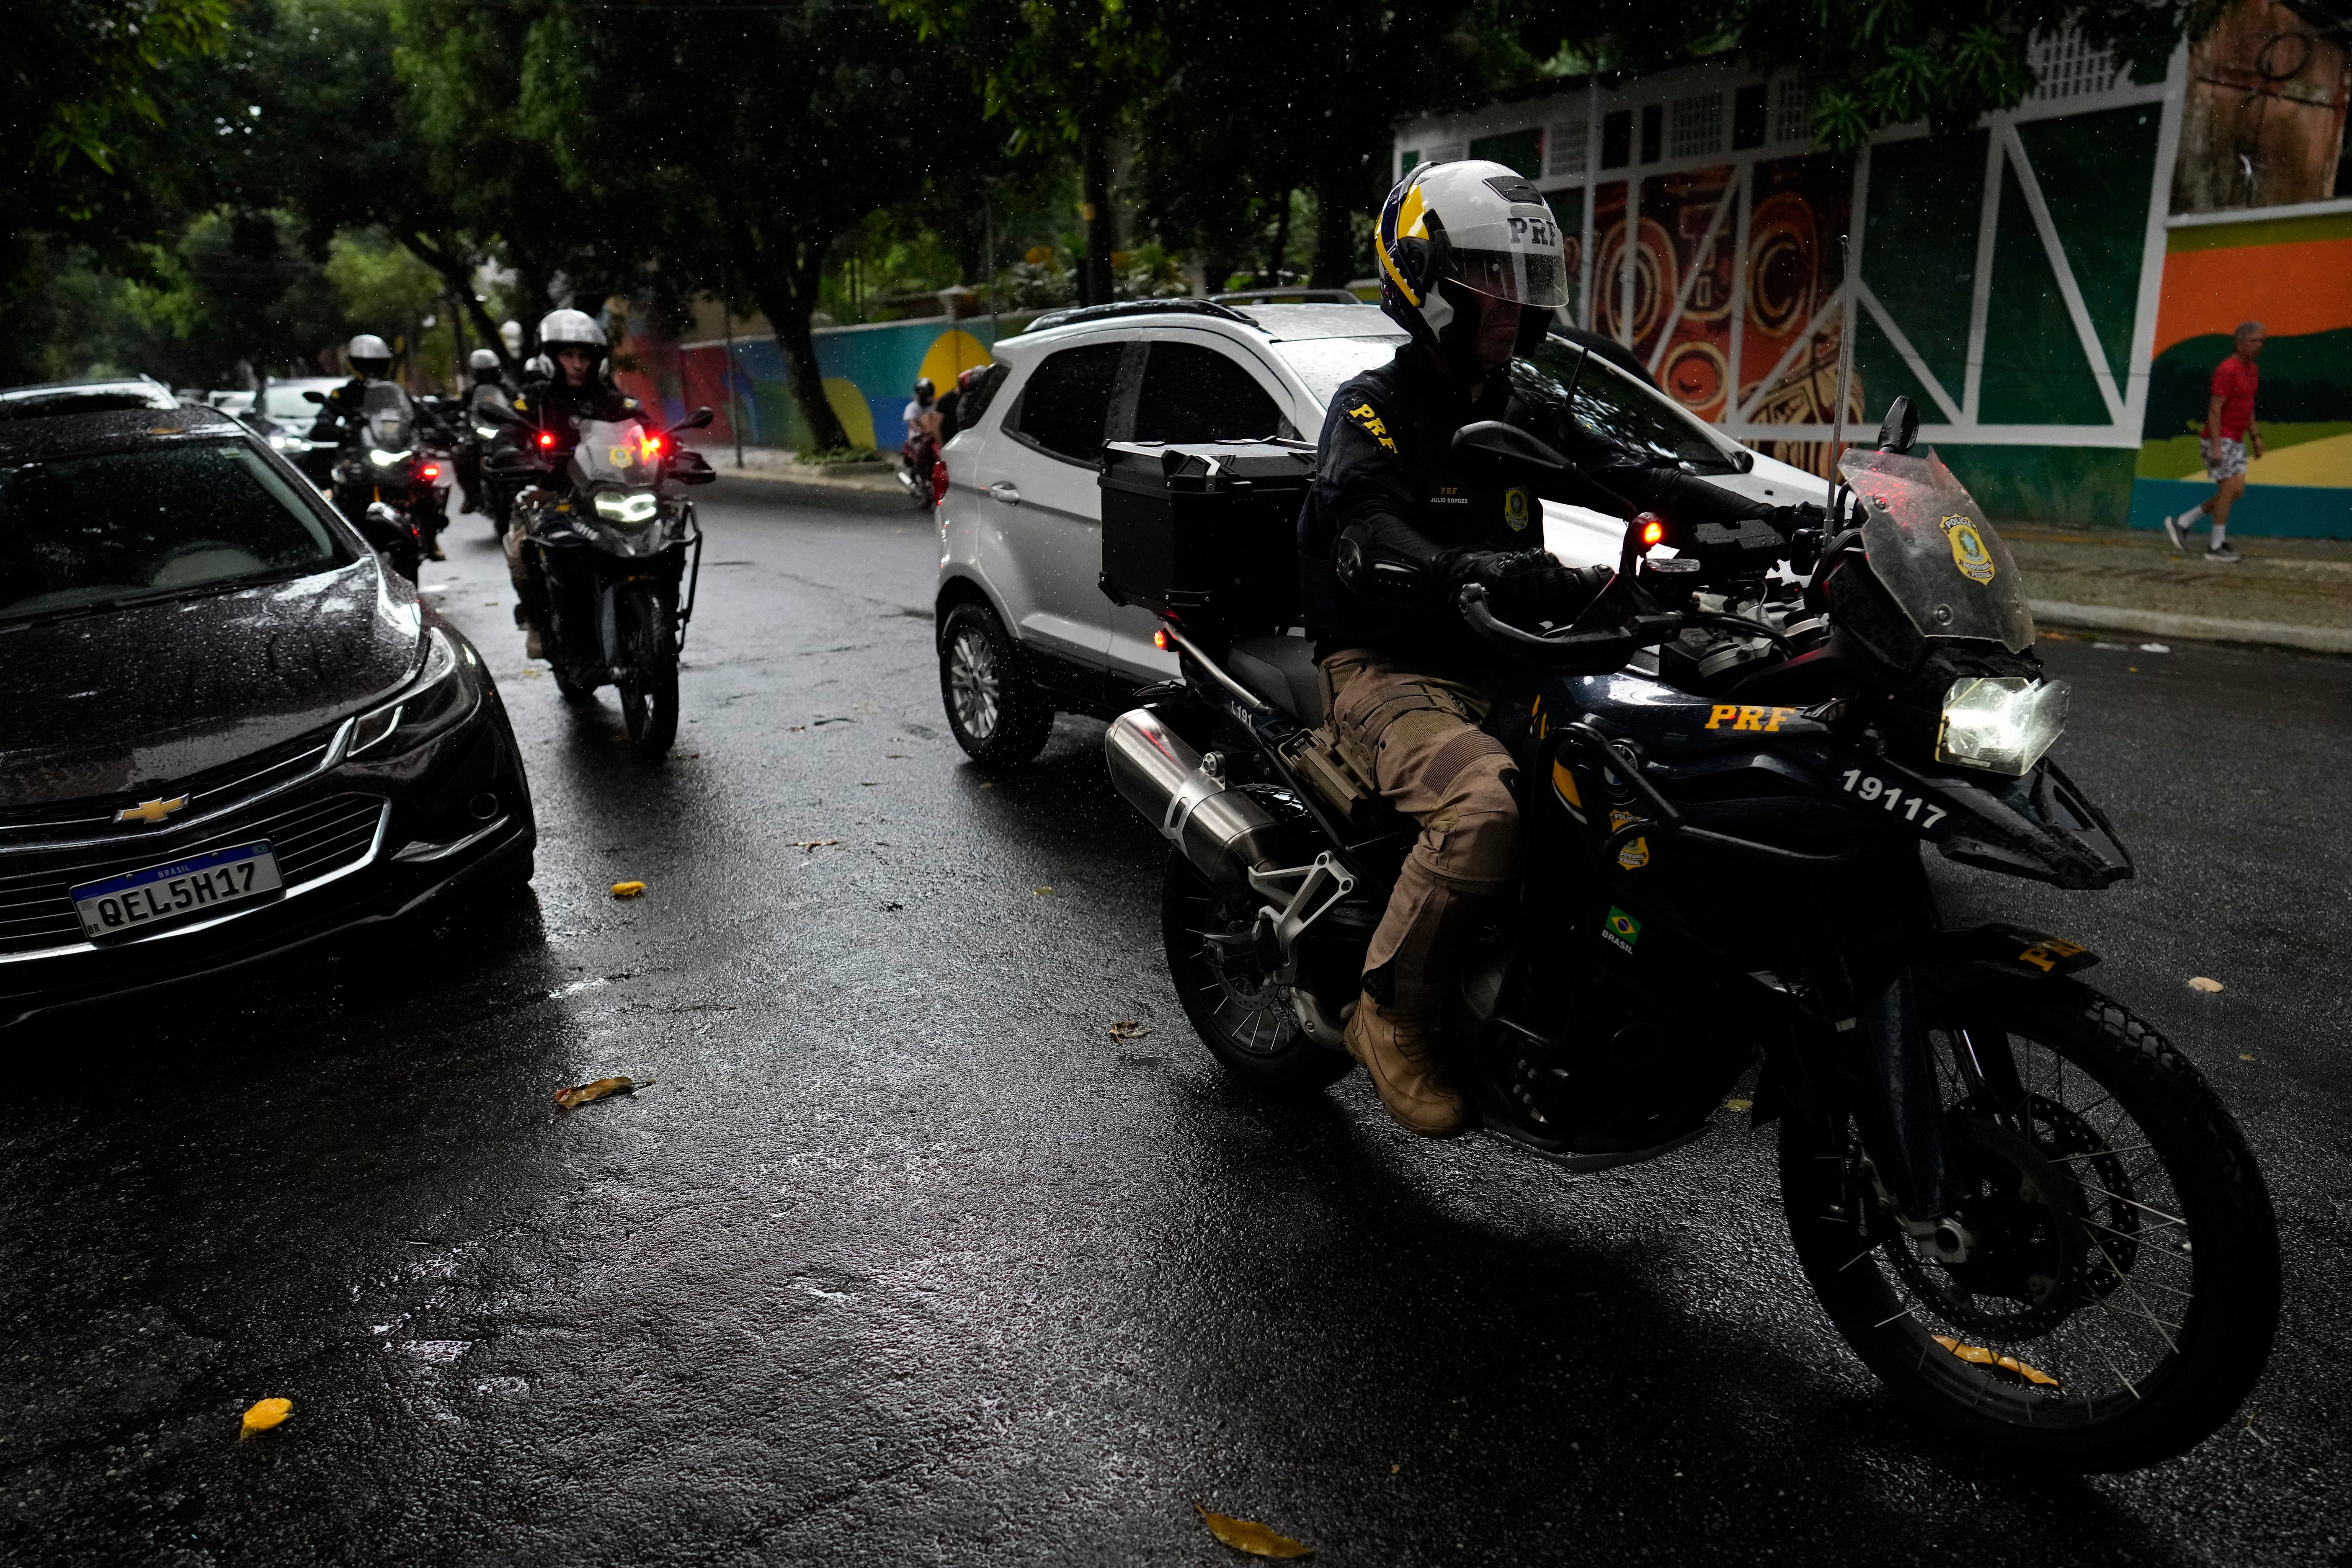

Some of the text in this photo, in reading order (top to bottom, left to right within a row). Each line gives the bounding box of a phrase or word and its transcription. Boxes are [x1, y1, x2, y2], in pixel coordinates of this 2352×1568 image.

[1349, 404, 1398, 454] PRF
[1237, 705, 1252, 727] 191
[1705, 705, 1796, 731] PRF
[1843, 769, 1947, 829] 19117
[157, 864, 191, 879] BRASIL
[97, 861, 255, 927] QEL5H17
[88, 923, 101, 935] BR
[1602, 929, 1633, 955] BRASIL
